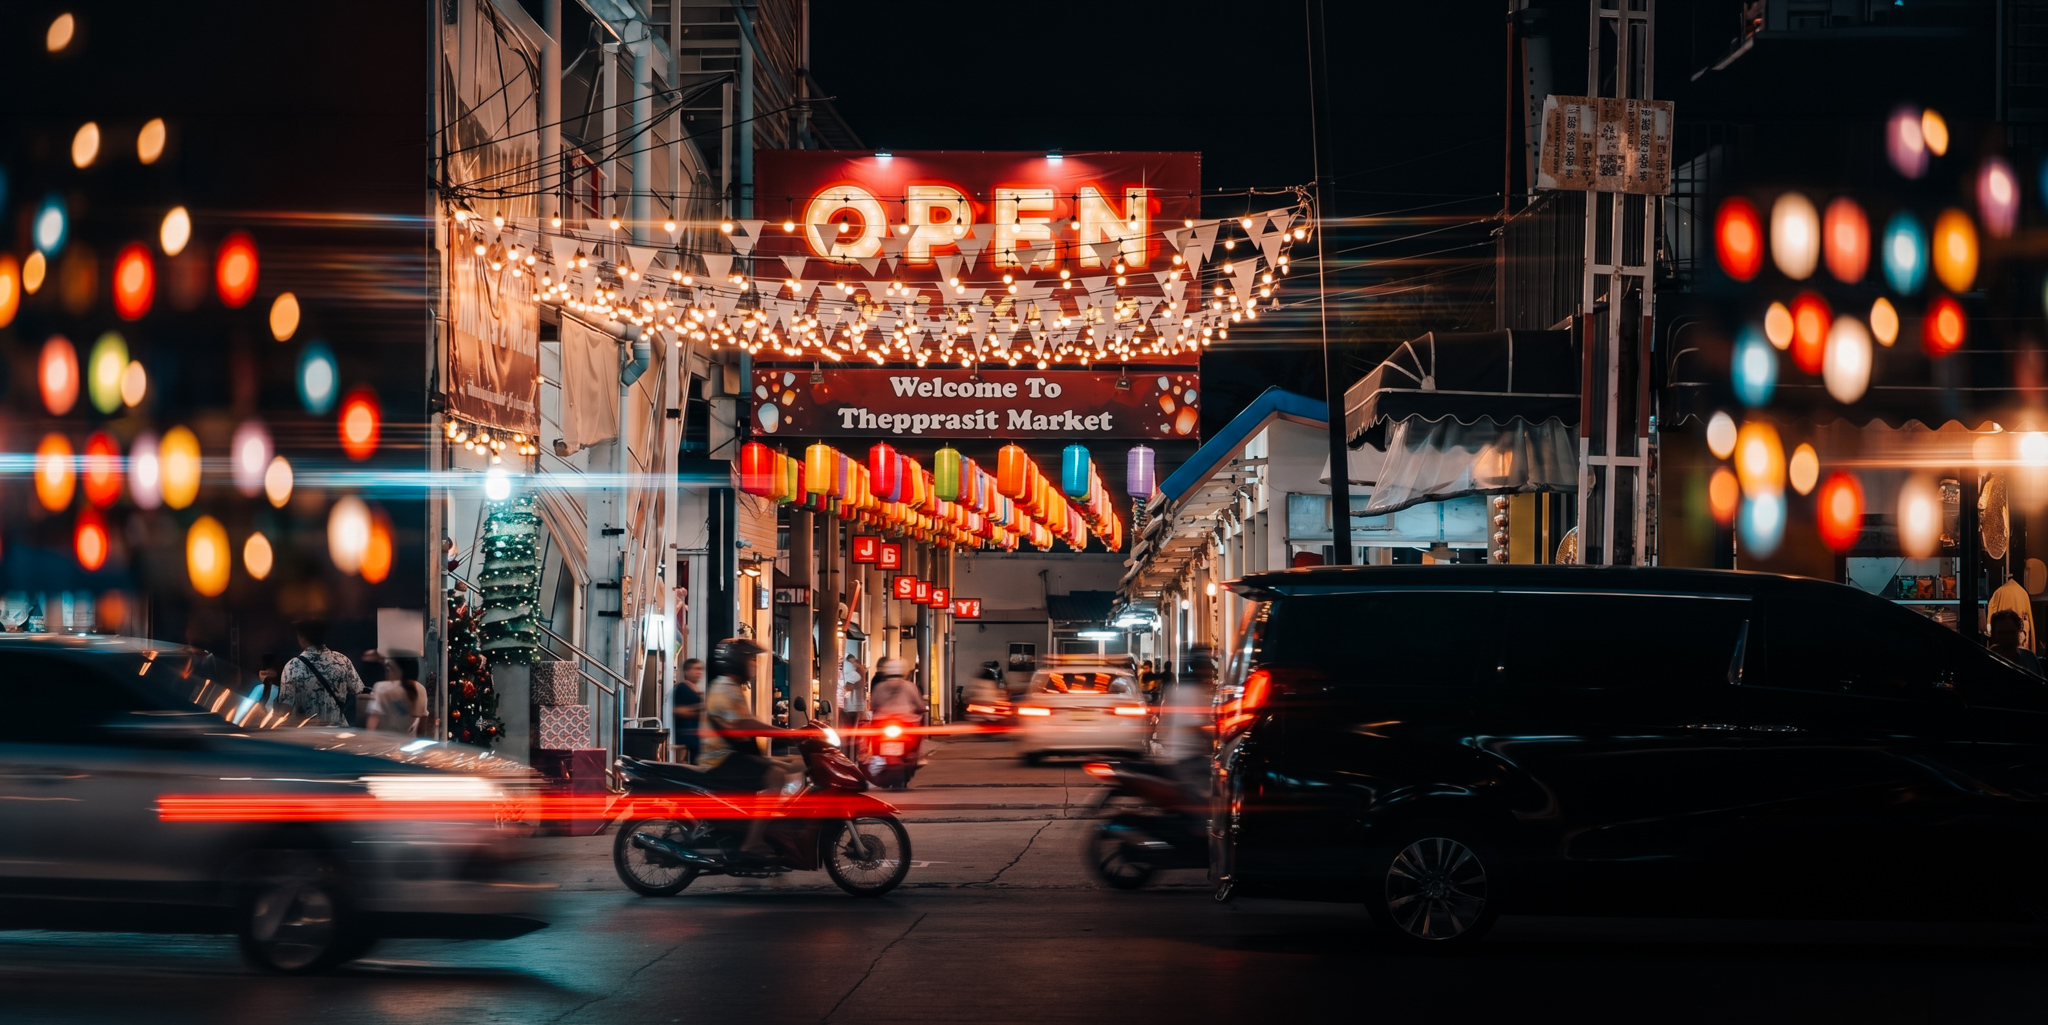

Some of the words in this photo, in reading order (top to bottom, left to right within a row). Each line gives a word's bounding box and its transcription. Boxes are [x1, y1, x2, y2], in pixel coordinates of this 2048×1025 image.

[805, 185, 1147, 268] OPEN
[889, 376, 1018, 398] Welcome
[1025, 377, 1062, 398] To
[838, 407, 999, 434] Thepprasit
[1006, 409, 1113, 431] Market
[861, 540, 873, 556] J
